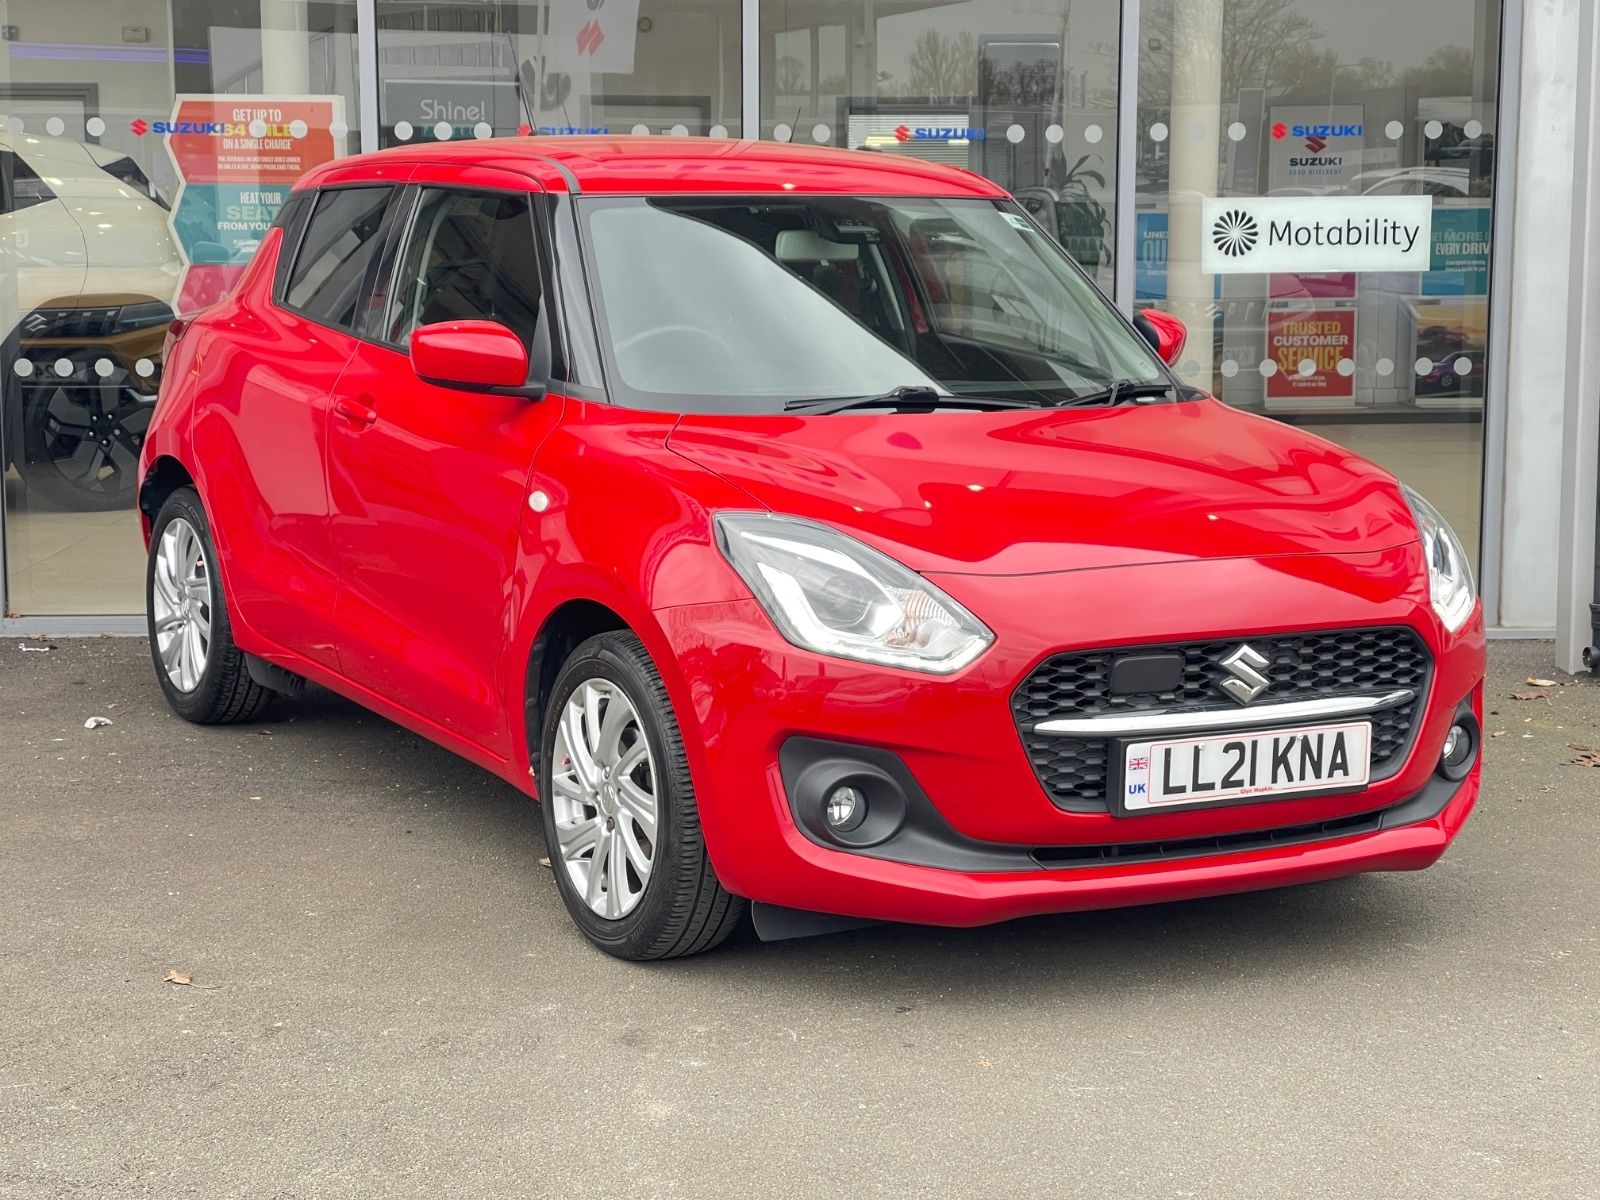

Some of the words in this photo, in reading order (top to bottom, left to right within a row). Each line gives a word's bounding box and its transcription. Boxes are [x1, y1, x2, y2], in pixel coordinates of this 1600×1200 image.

[232, 108, 250, 121] GET
[253, 108, 267, 121] UP
[269, 108, 281, 121] TO
[420, 99, 485, 121] Shine!
[152, 122, 225, 133] SUZUKI
[915, 127, 985, 139] SUZUKI
[1292, 125, 1363, 137] SUZUKI
[223, 138, 234, 149] ON
[240, 138, 263, 149] SINGLE
[1289, 157, 1343, 167] SUZUKI
[240, 191, 259, 204] HEAT
[260, 191, 281, 204] YOUR
[217, 222, 247, 230] FROM
[1269, 218, 1420, 252] Motability
[1444, 231, 1483, 241] MORE
[1435, 242, 1460, 255] EVERY
[1283, 321, 1341, 334] TRUSTED
[1273, 335, 1349, 346] CUSTOMER
[1162, 739, 1259, 795] LL21
[1271, 731, 1350, 784] KNA
[1128, 783, 1147, 795] UK
